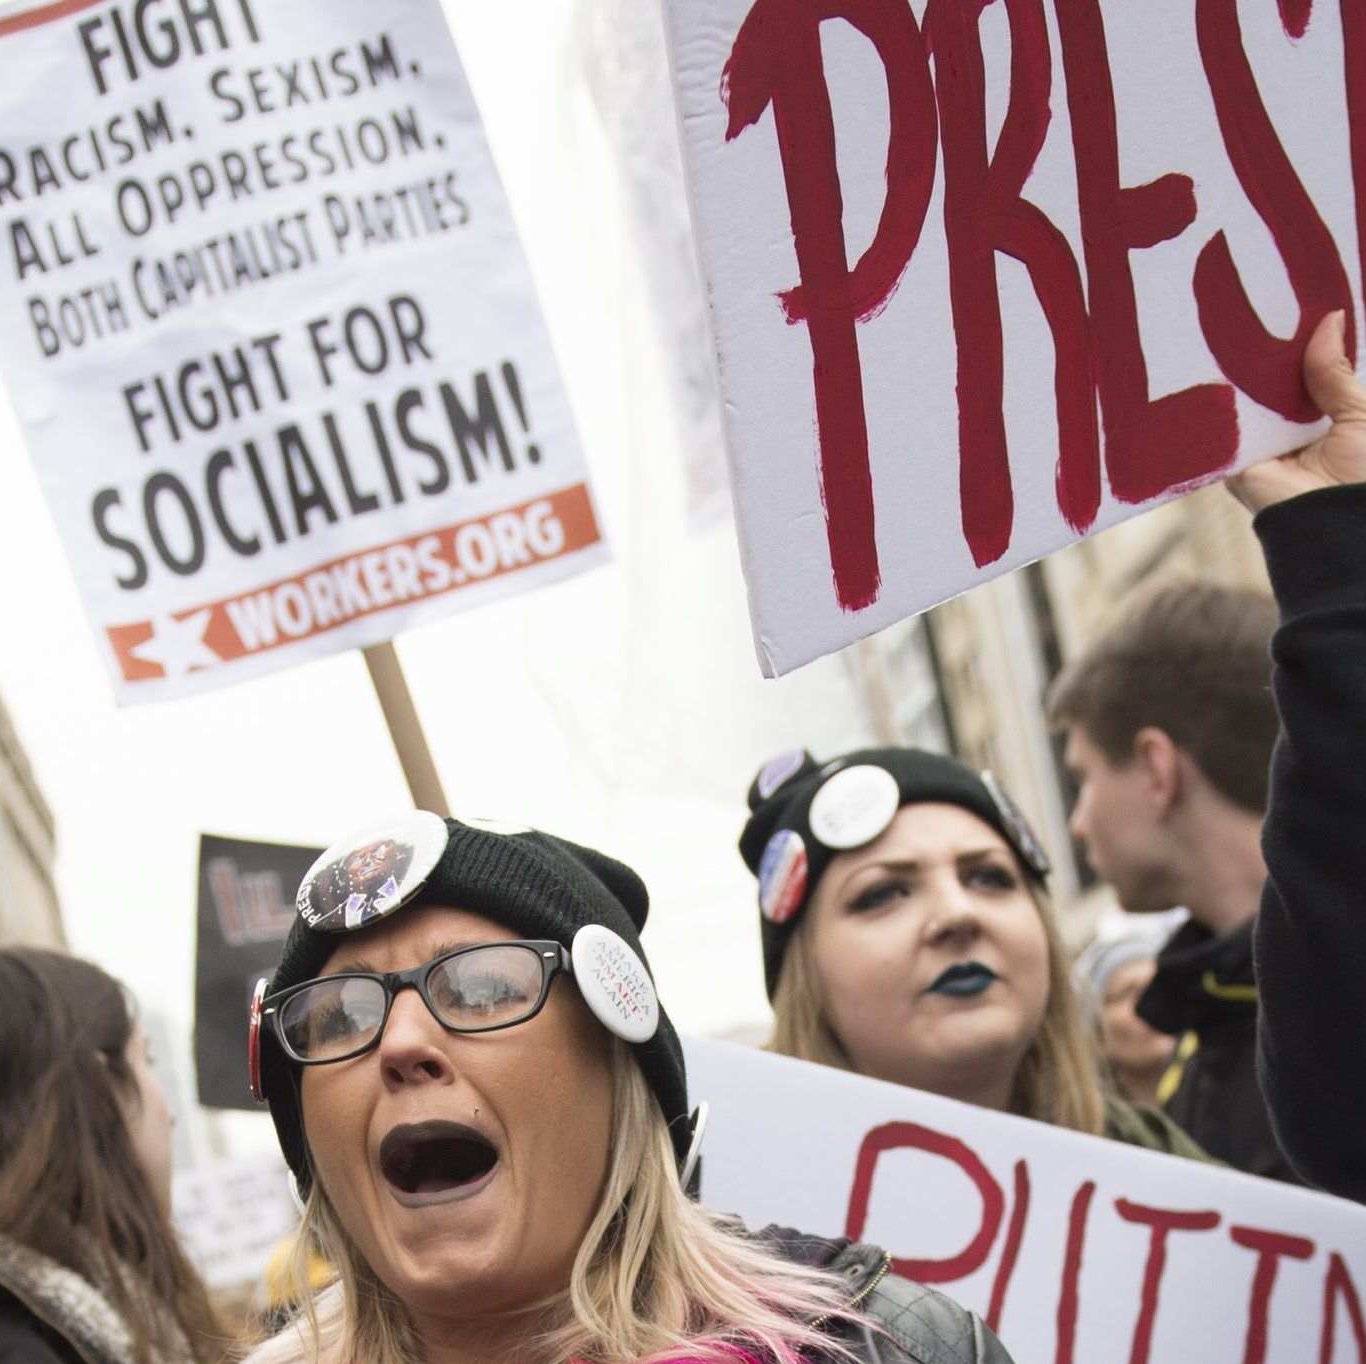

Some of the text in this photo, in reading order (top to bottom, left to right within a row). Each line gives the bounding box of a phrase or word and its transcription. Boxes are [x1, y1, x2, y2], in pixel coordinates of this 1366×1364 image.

[9, 221, 98, 280] ALL
[27, 173, 471, 358] BOTH CAPITALIST PARTIES
[124, 296, 432, 452] FIGHT FOR
[92, 362, 541, 590] SOCIALISM!
[229, 502, 565, 654] WORKERS.ORG
